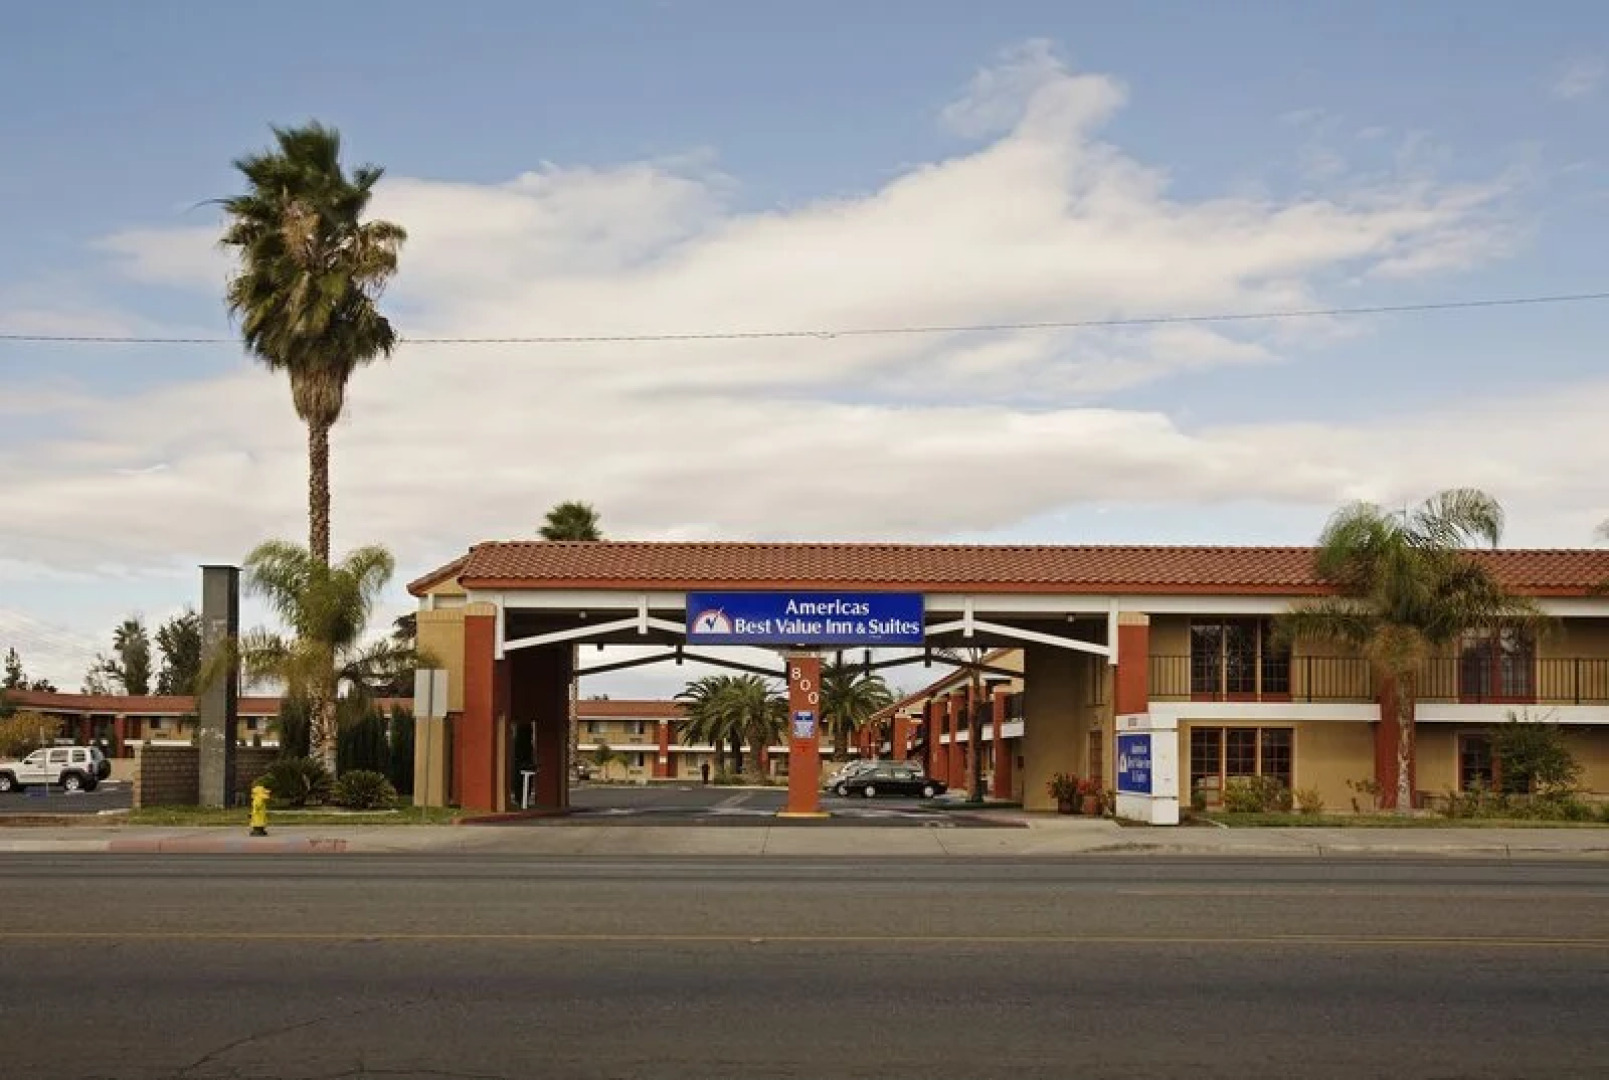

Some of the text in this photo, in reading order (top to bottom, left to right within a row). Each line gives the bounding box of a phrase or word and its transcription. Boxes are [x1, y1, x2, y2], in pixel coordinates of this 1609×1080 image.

[785, 599, 870, 615] Americas
[735, 619, 920, 634] Best Value Inn & Suites
